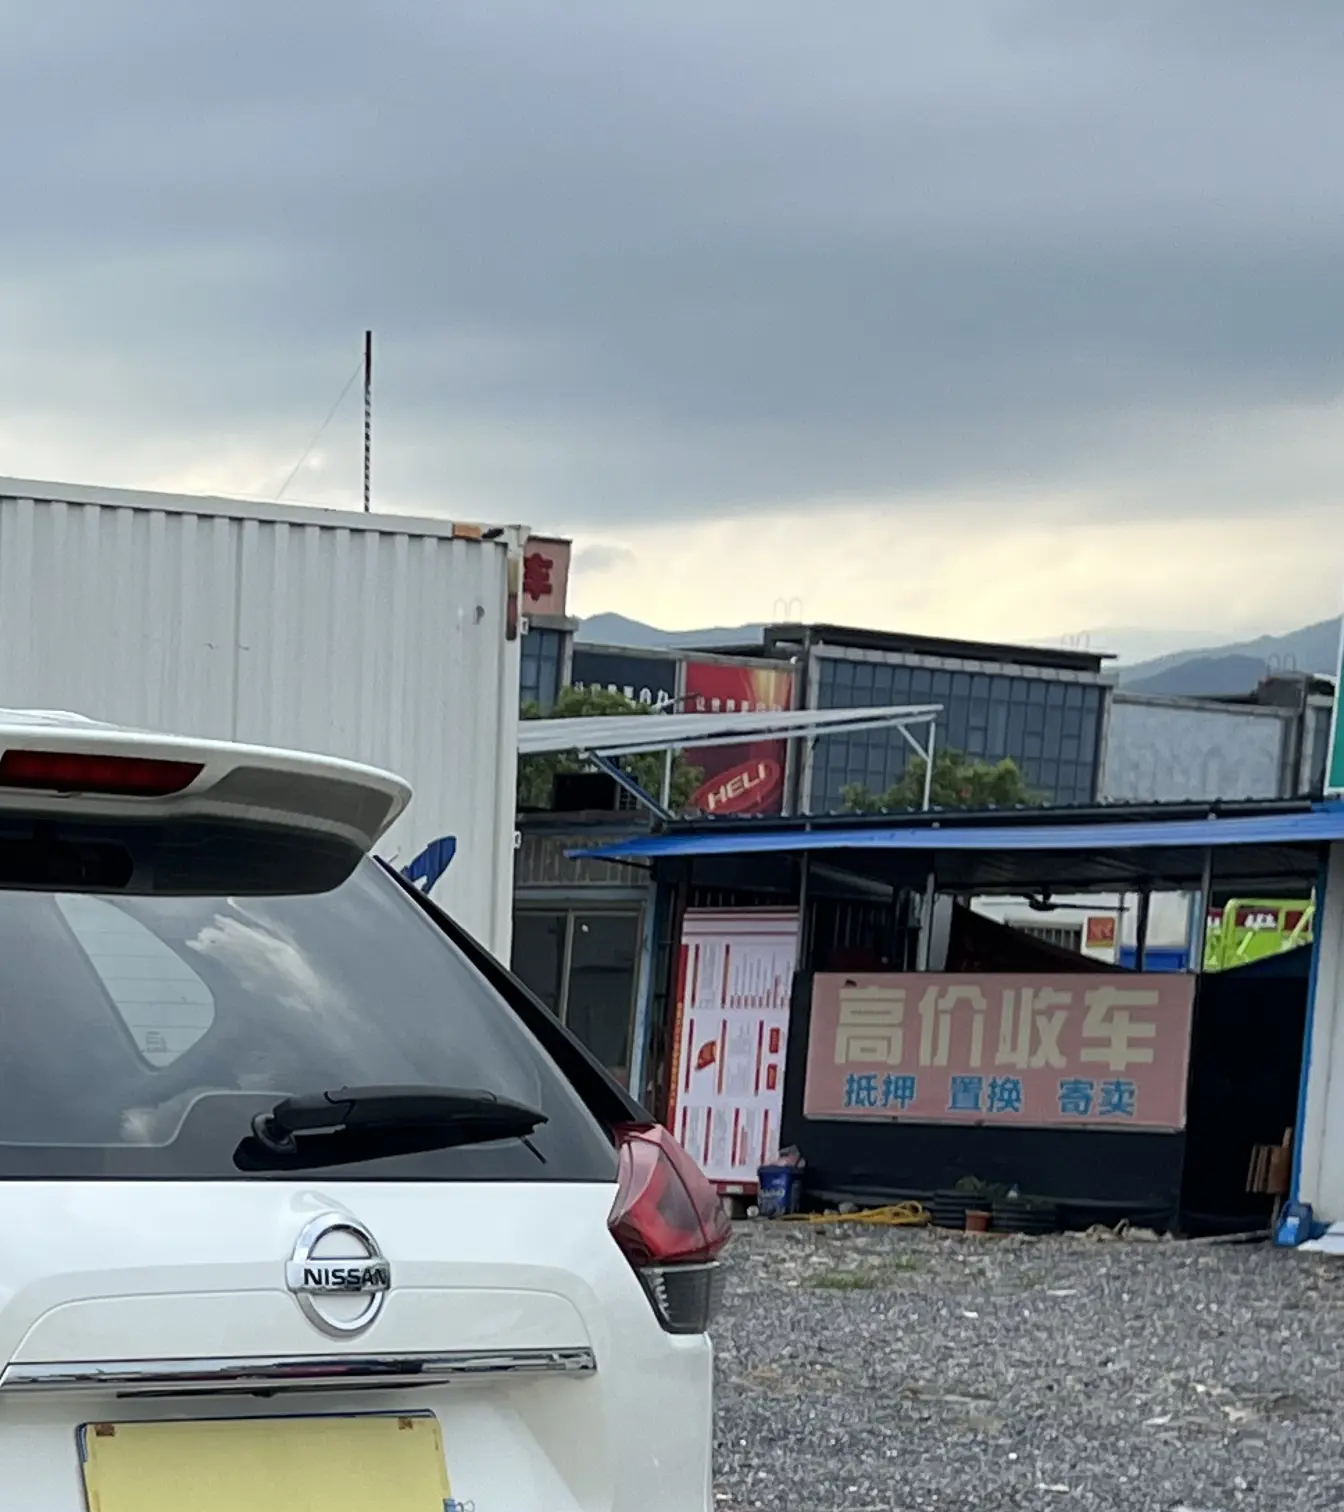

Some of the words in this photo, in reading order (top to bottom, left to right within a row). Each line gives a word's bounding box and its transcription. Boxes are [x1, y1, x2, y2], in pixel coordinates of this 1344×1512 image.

[708, 763, 767, 810] HELI
[834, 985, 1159, 1072] 高价收车
[844, 1073, 916, 1109] 抵押
[946, 1075, 1023, 1113] 置换
[1057, 1077, 1139, 1118] 寄卖
[303, 1268, 387, 1286] NISSAN
